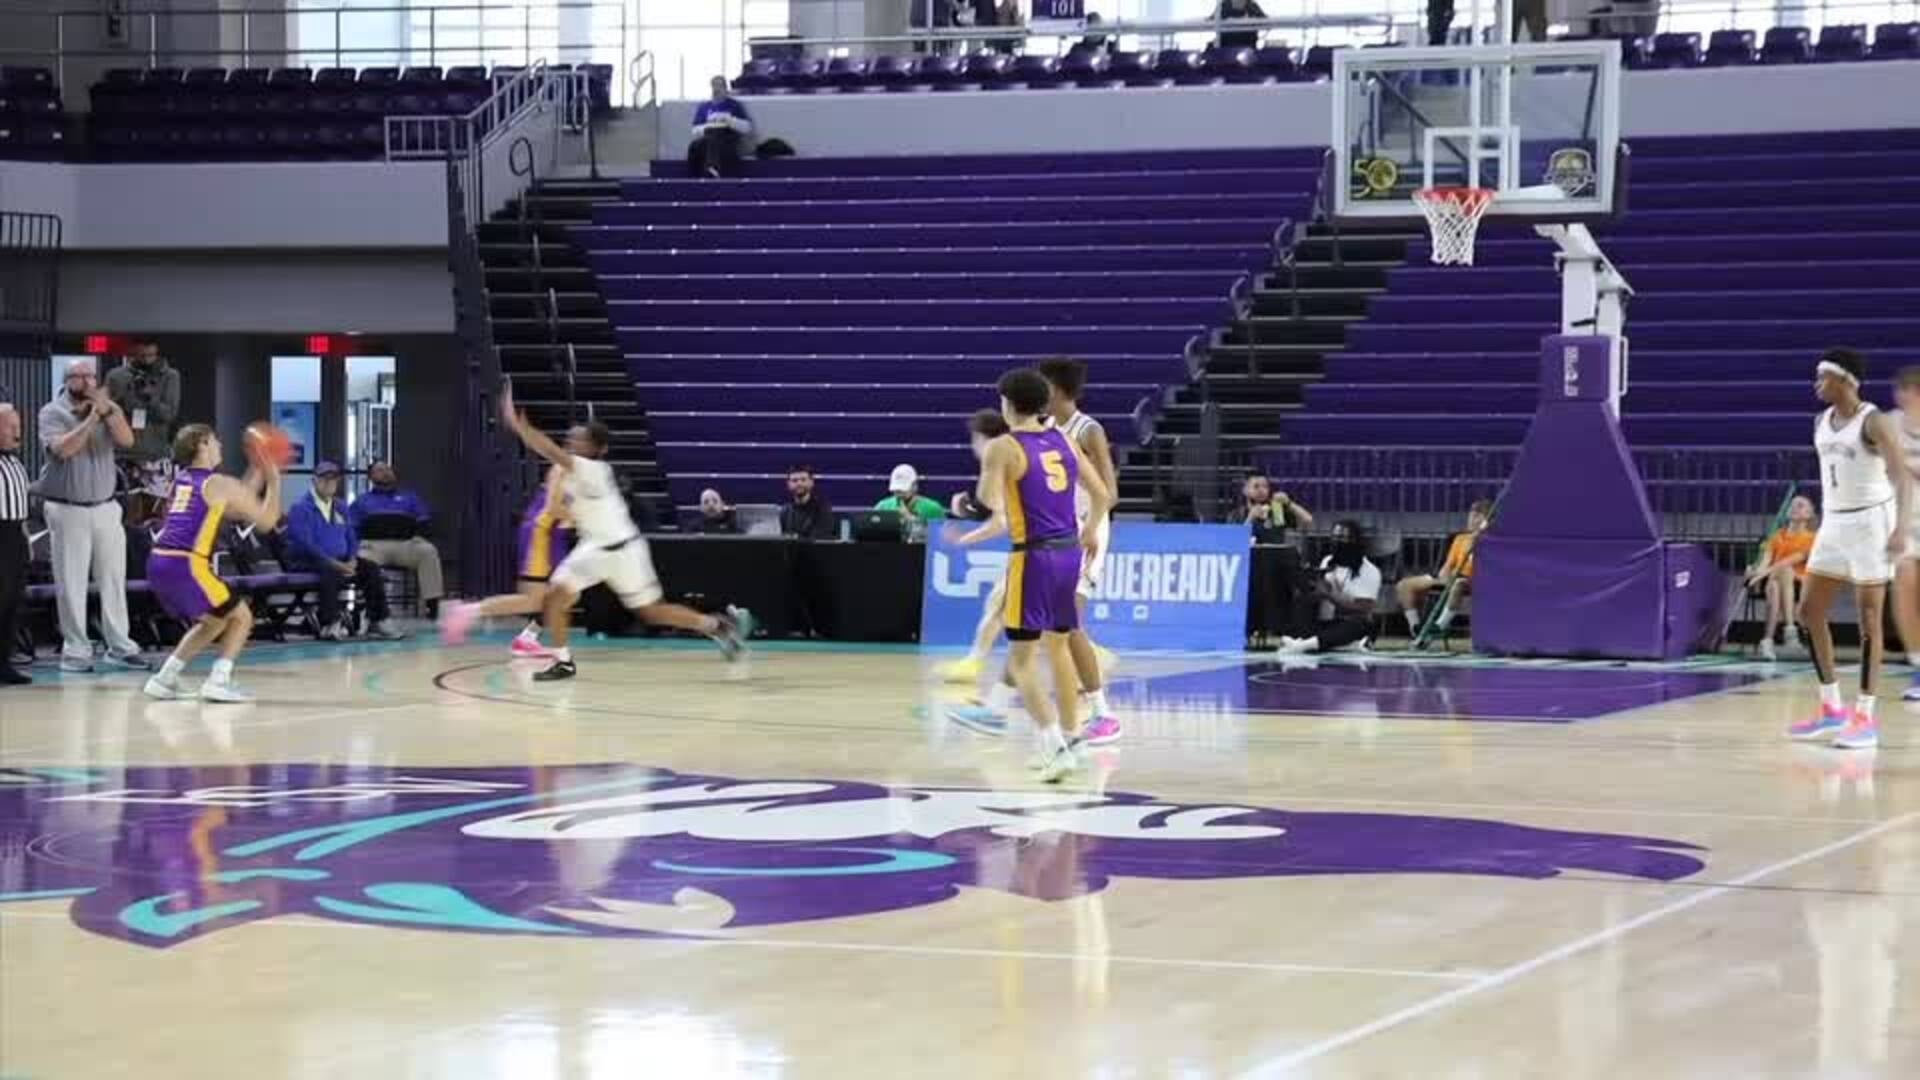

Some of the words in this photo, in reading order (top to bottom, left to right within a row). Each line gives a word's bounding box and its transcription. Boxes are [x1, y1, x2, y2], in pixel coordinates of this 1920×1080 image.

[1051, 0, 1076, 16] 101
[1040, 450, 1067, 492] 5
[1830, 464, 1838, 488] 1
